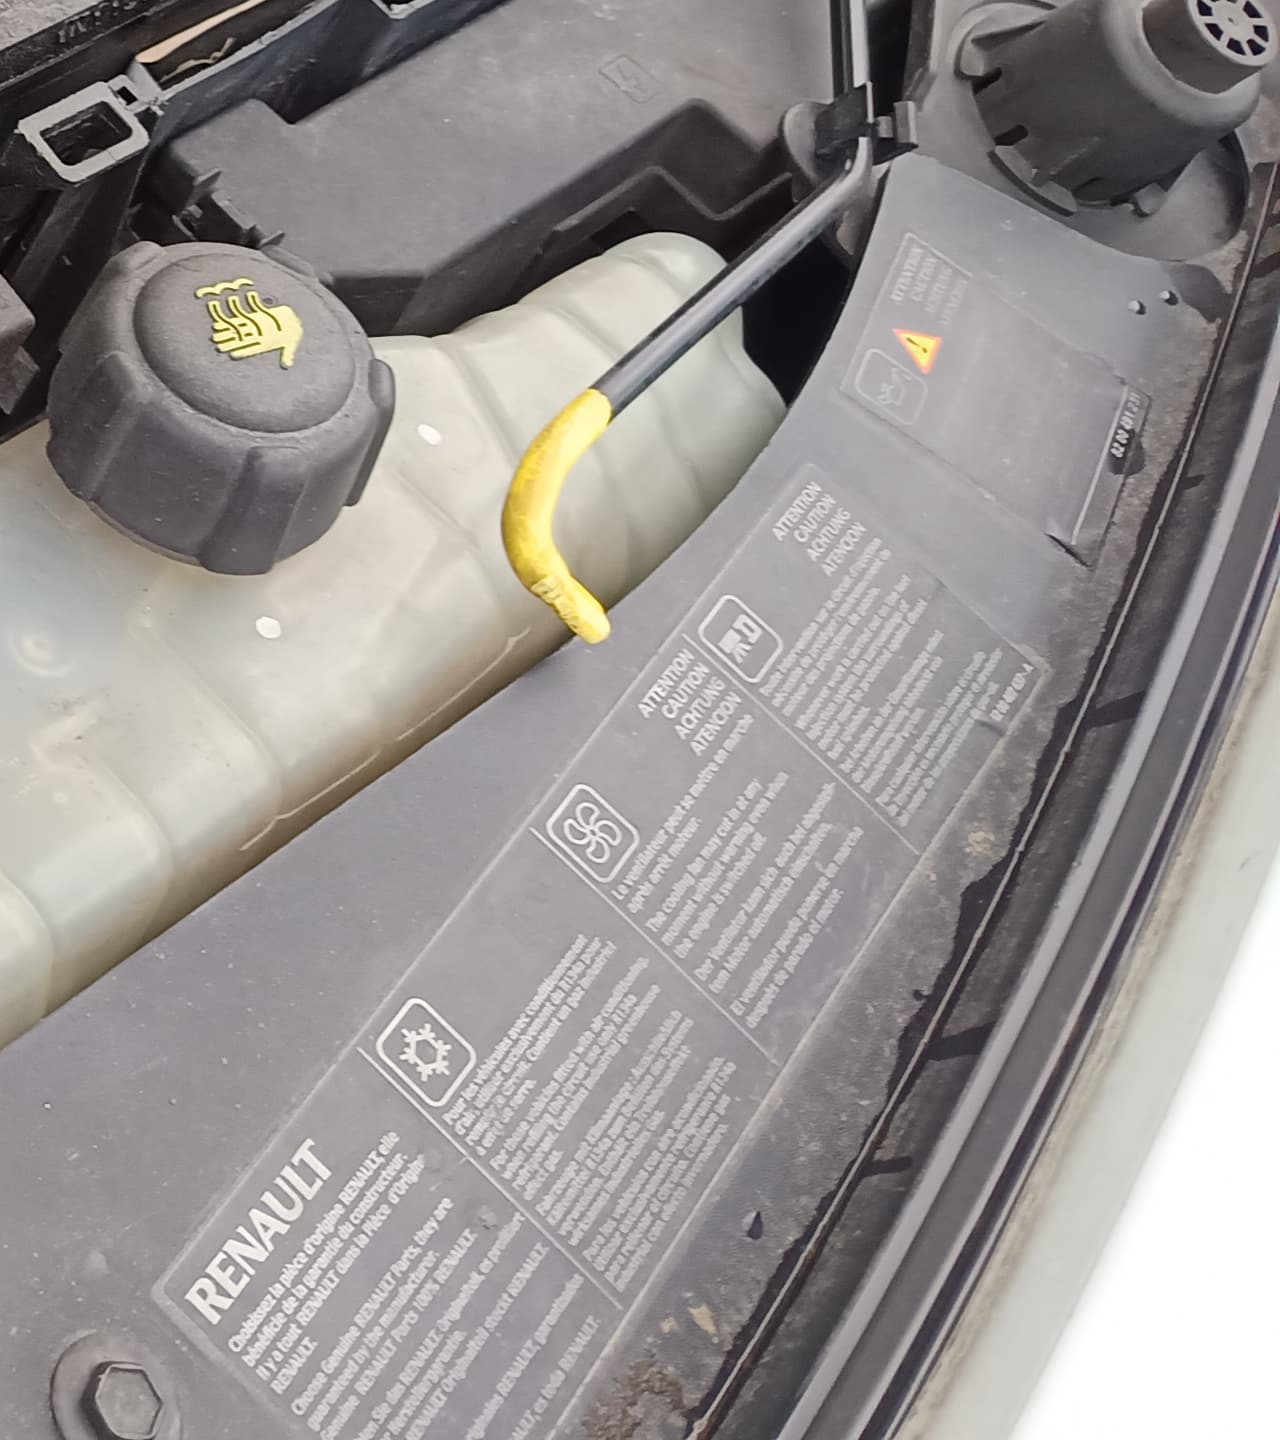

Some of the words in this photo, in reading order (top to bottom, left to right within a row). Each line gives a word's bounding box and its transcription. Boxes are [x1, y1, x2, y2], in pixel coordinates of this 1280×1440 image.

[769, 478, 823, 543] ATTENTION
[791, 491, 837, 545] CAUTION
[804, 505, 852, 563] ACHTUNG
[820, 519, 867, 578] ATENCION
[634, 645, 695, 720] ATTENTION
[659, 659, 710, 722] CAUTION
[671, 673, 726, 742] ACHTUNG
[688, 689, 742, 757] ATENCION
[721, 711, 754, 753] marche
[687, 758, 719, 798] mettre
[713, 747, 729, 765] en
[661, 804, 688, 835] peut
[681, 794, 695, 810] se
[621, 826, 670, 888] ventilateur
[645, 907, 668, 934] The
[659, 870, 695, 916] cooling
[699, 833, 723, 861] may
[714, 815, 733, 838] cut
[726, 805, 740, 821] in
[742, 777, 763, 802] any
[660, 898, 697, 947] moment
[718, 819, 755, 867] warning
[747, 796, 770, 825] even
[611, 880, 629, 901] Le
[624, 878, 657, 917] après
[673, 934, 694, 960] the
[375, 1127, 400, 1156] elle
[337, 1147, 385, 1208] RENAULT,
[183, 1135, 337, 1328] RENAULT
[300, 1199, 347, 1257] d'origine
[353, 1229, 370, 1249] la
[361, 1199, 392, 1237] Pièce
[240, 1307, 288, 1369] bénéficie
[279, 1292, 300, 1316] de
[291, 1280, 309, 1300] la
[300, 1233, 345, 1290] garantie
[335, 1218, 355, 1242] du
[347, 1147, 408, 1226] constructeur.
[276, 1247, 311, 1289] pièce
[333, 1241, 361, 1275] dans
[505, 1238, 549, 1298] RENAULT.
[268, 1280, 285, 1299] la
[289, 1368, 328, 1417] Choose
[319, 1322, 361, 1376] Genuine
[353, 1270, 398, 1329] RENAULT
[390, 1239, 421, 1279] Parts,
[413, 1214, 441, 1248] they
[432, 1195, 454, 1222] are
[295, 1268, 342, 1328] RENAULT
[226, 1291, 277, 1355] Choisissez
[276, 1321, 303, 1354] tout
[306, 1360, 361, 1433] guaranteed
[352, 1344, 371, 1366] by
[364, 1323, 384, 1349] the
[378, 1246, 440, 1329] manufacturer.
[320, 1391, 361, 1440] Genuine
[353, 1338, 398, 1396] RENAULT
[391, 1308, 419, 1344] Parts
[413, 1277, 441, 1312] 100%
[433, 1226, 477, 1285] RENAULT.
[557, 1312, 601, 1373] RENAULT.
[269, 1333, 318, 1396] RENAULT.
[495, 1336, 541, 1398] RENAULT,
[370, 1399, 391, 1425] Sie
